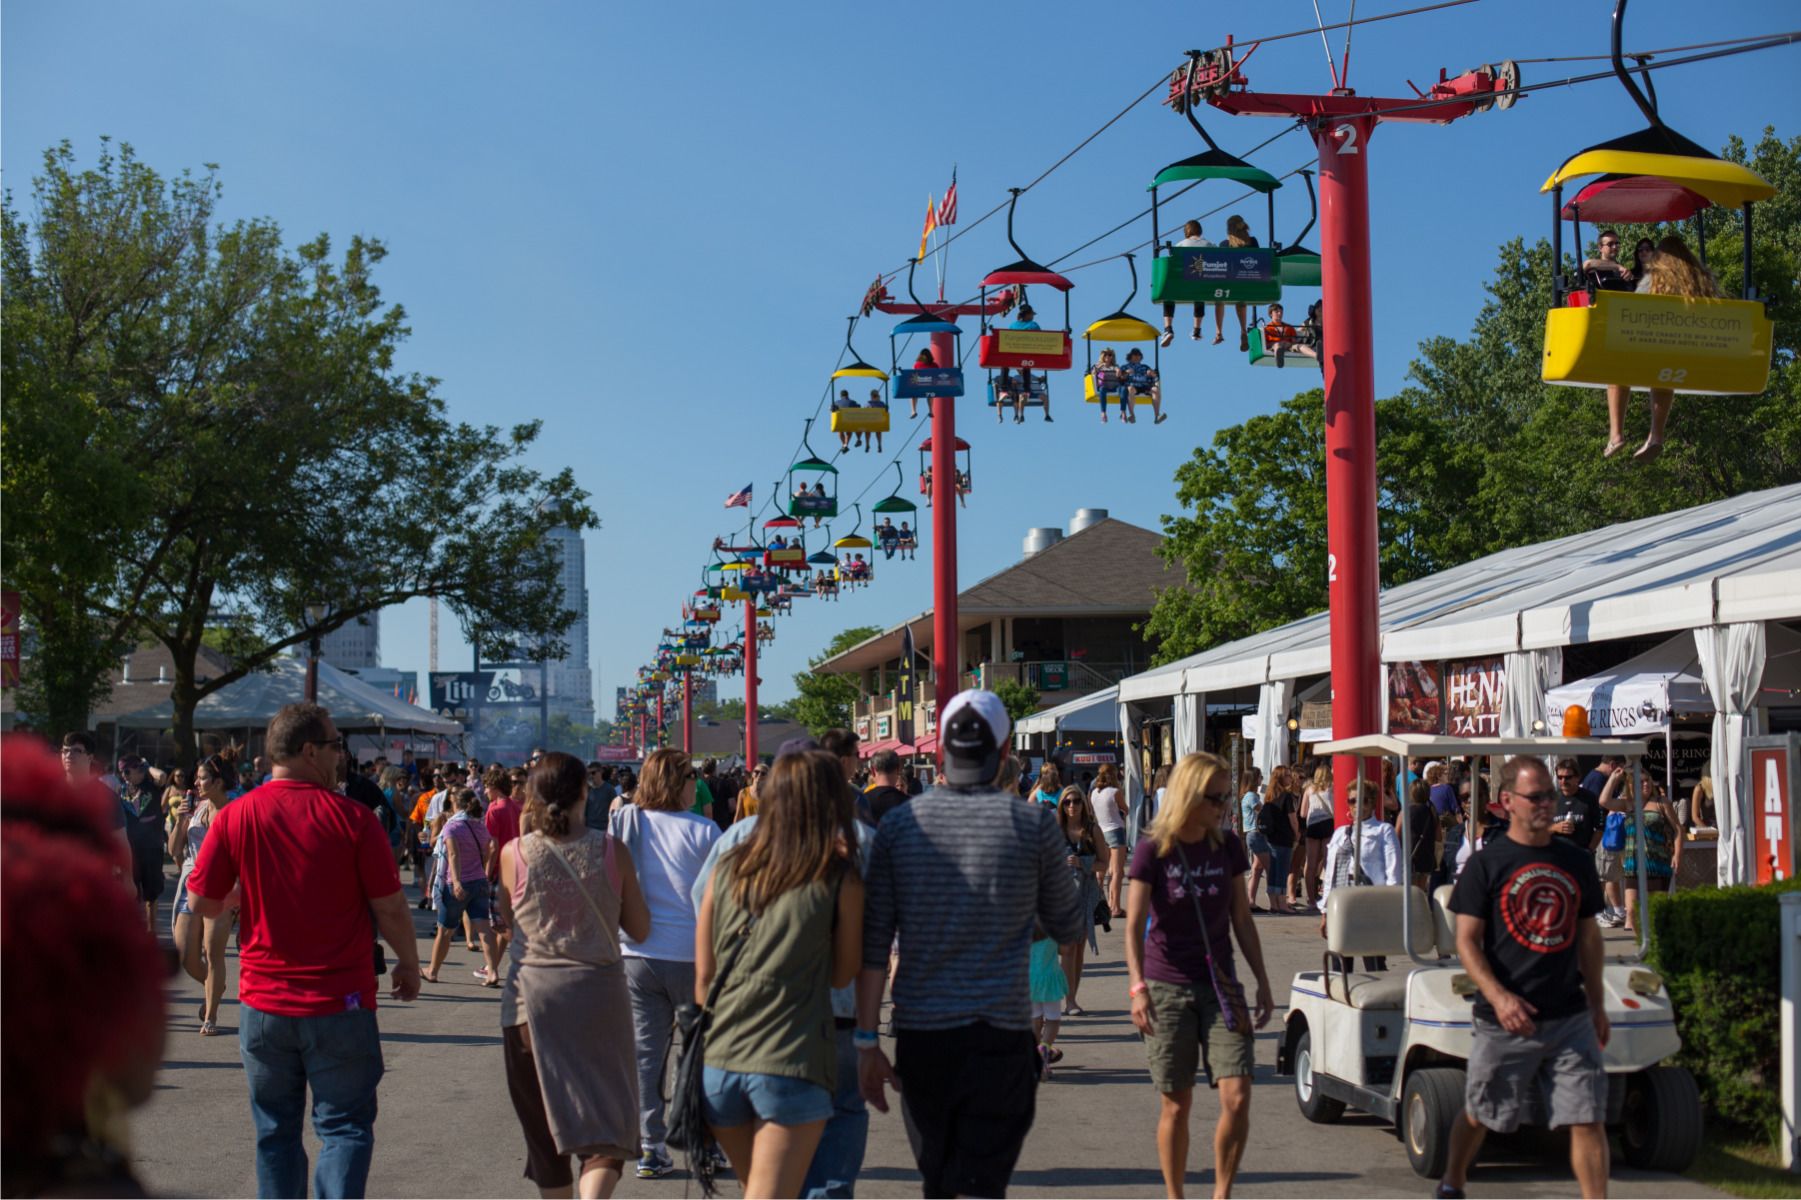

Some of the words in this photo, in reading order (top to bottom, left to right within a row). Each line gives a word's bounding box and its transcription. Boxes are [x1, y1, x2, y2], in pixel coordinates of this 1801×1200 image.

[1335, 123, 1358, 155] 2
[1214, 288, 1231, 298] 81
[1620, 307, 1742, 331] FunjetRocks.com
[1658, 367, 1688, 383] 82
[1328, 553, 1337, 582] 2
[898, 657, 913, 721] ATM
[1452, 713, 1500, 735] TATT
[1598, 706, 1638, 730] RINGS
[1763, 758, 1784, 881] AT
